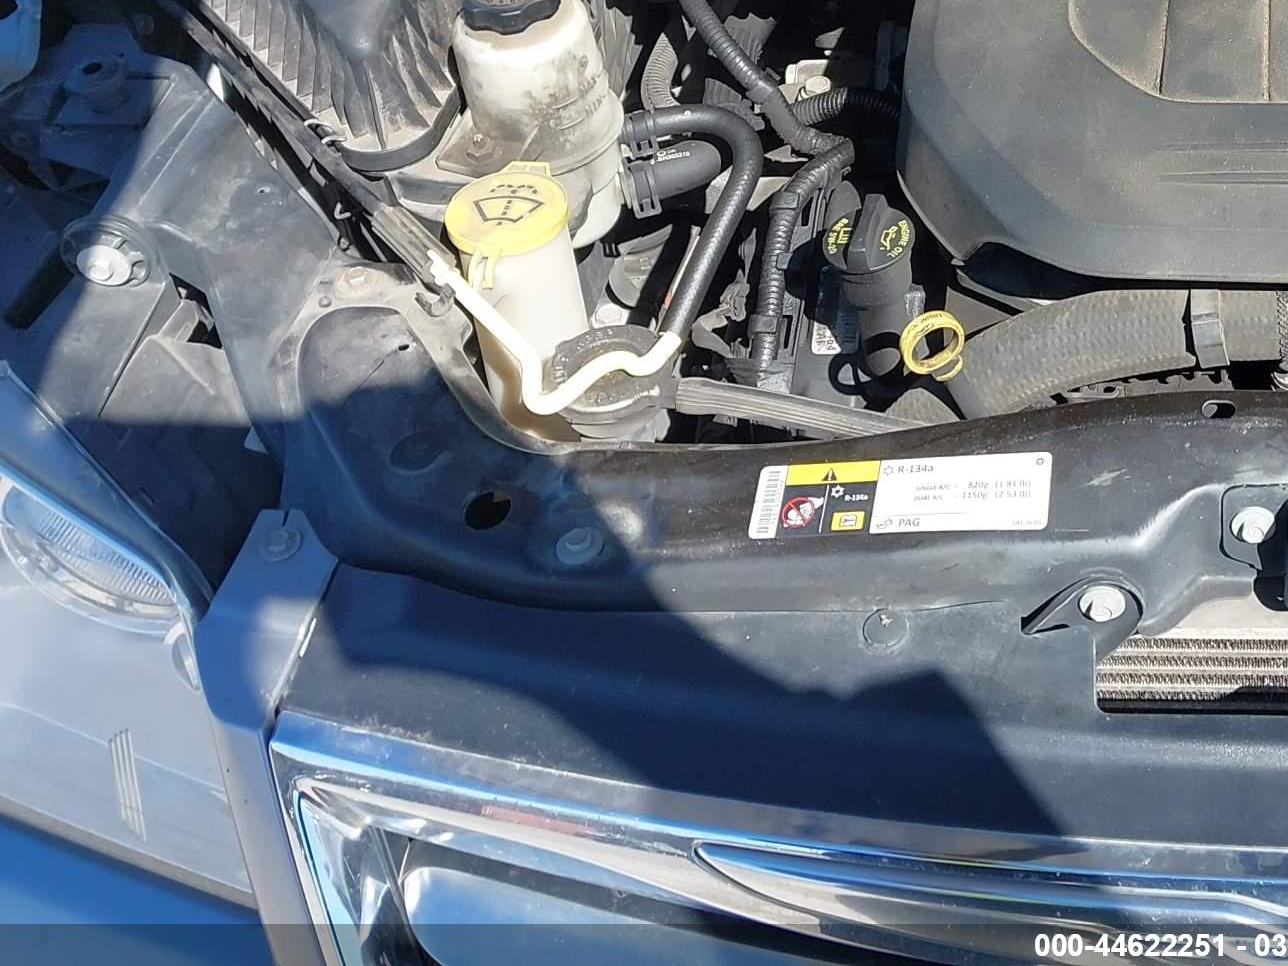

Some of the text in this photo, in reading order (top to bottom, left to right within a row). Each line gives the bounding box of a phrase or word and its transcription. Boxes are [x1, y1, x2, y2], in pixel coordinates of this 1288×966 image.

[886, 219, 911, 258] ENGINE OIL
[897, 463, 934, 474] R-134a
[898, 516, 920, 527] PAG
